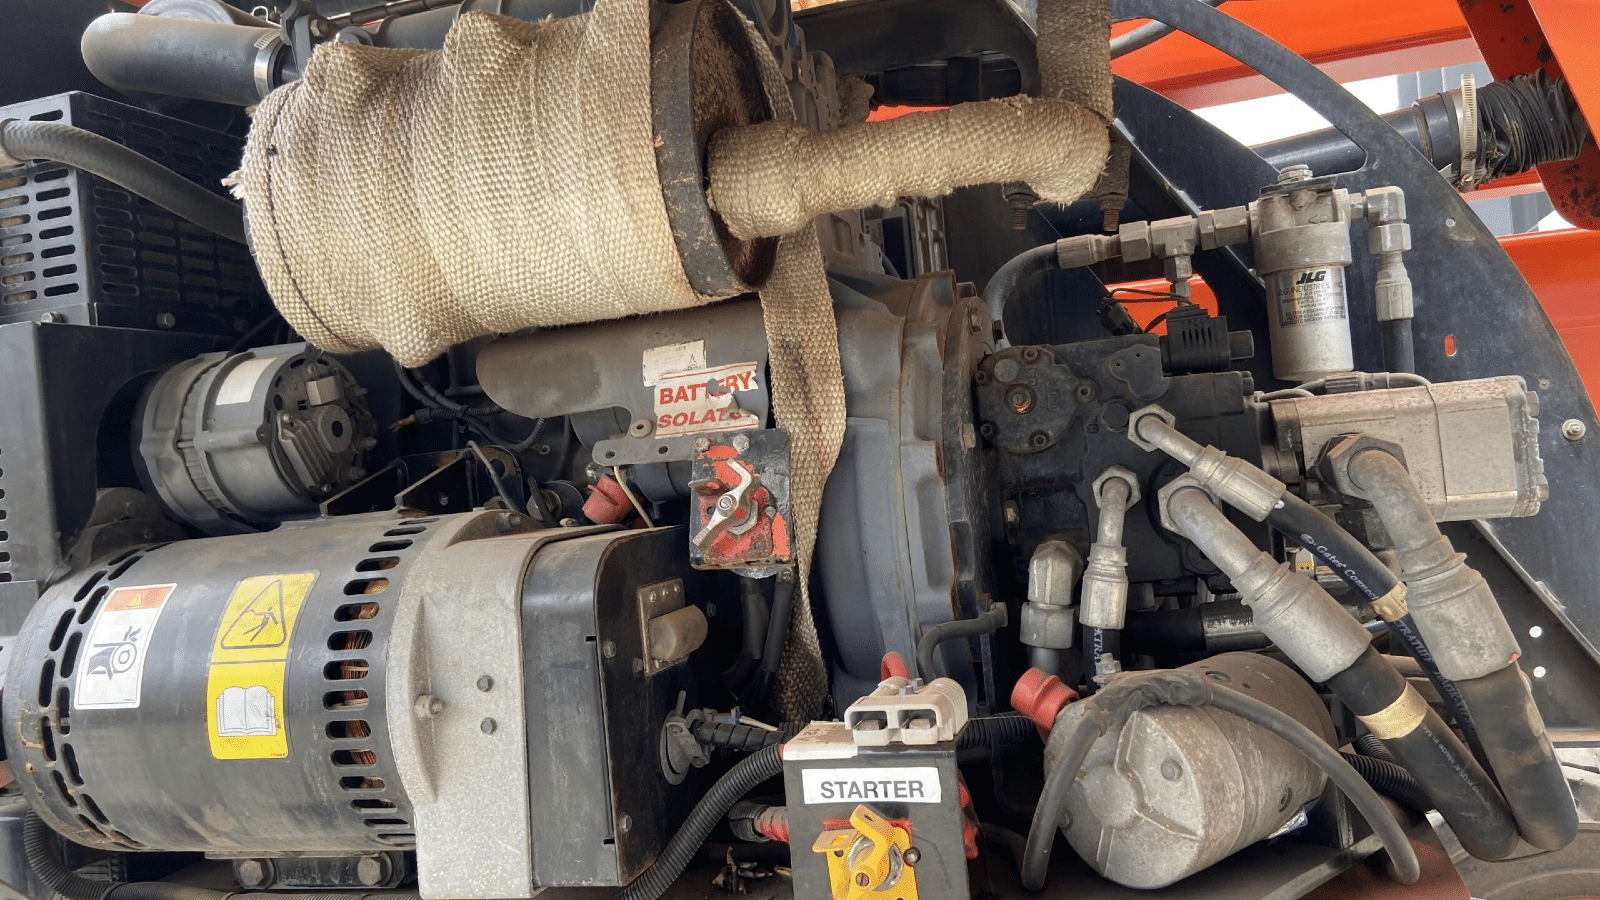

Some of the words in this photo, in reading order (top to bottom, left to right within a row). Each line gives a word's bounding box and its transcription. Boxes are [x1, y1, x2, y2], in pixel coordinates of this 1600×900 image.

[1296, 270, 1327, 285] JLG
[657, 407, 751, 429] SOLAT
[820, 780, 925, 799] STARTER
